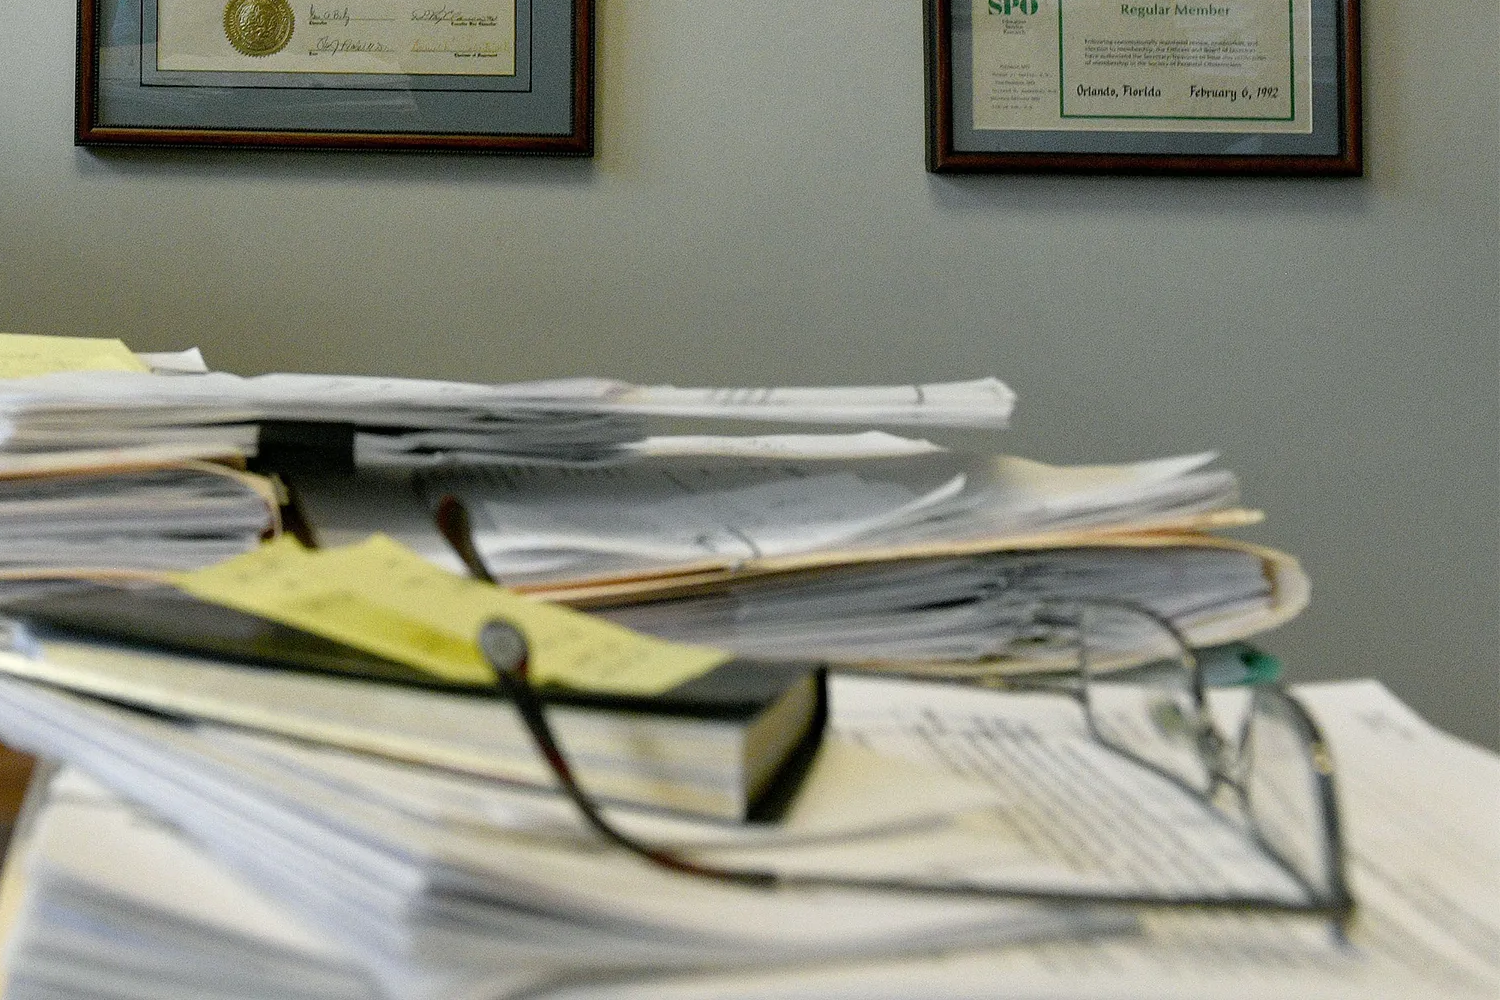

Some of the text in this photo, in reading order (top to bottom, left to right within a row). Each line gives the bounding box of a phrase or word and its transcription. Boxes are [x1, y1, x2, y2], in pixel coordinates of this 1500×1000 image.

[1121, 3, 1230, 18] Regular Member
[1077, 84, 1161, 99] Orlando, Florida
[1189, 85, 1237, 101] February
[1257, 87, 1279, 98] 1992
